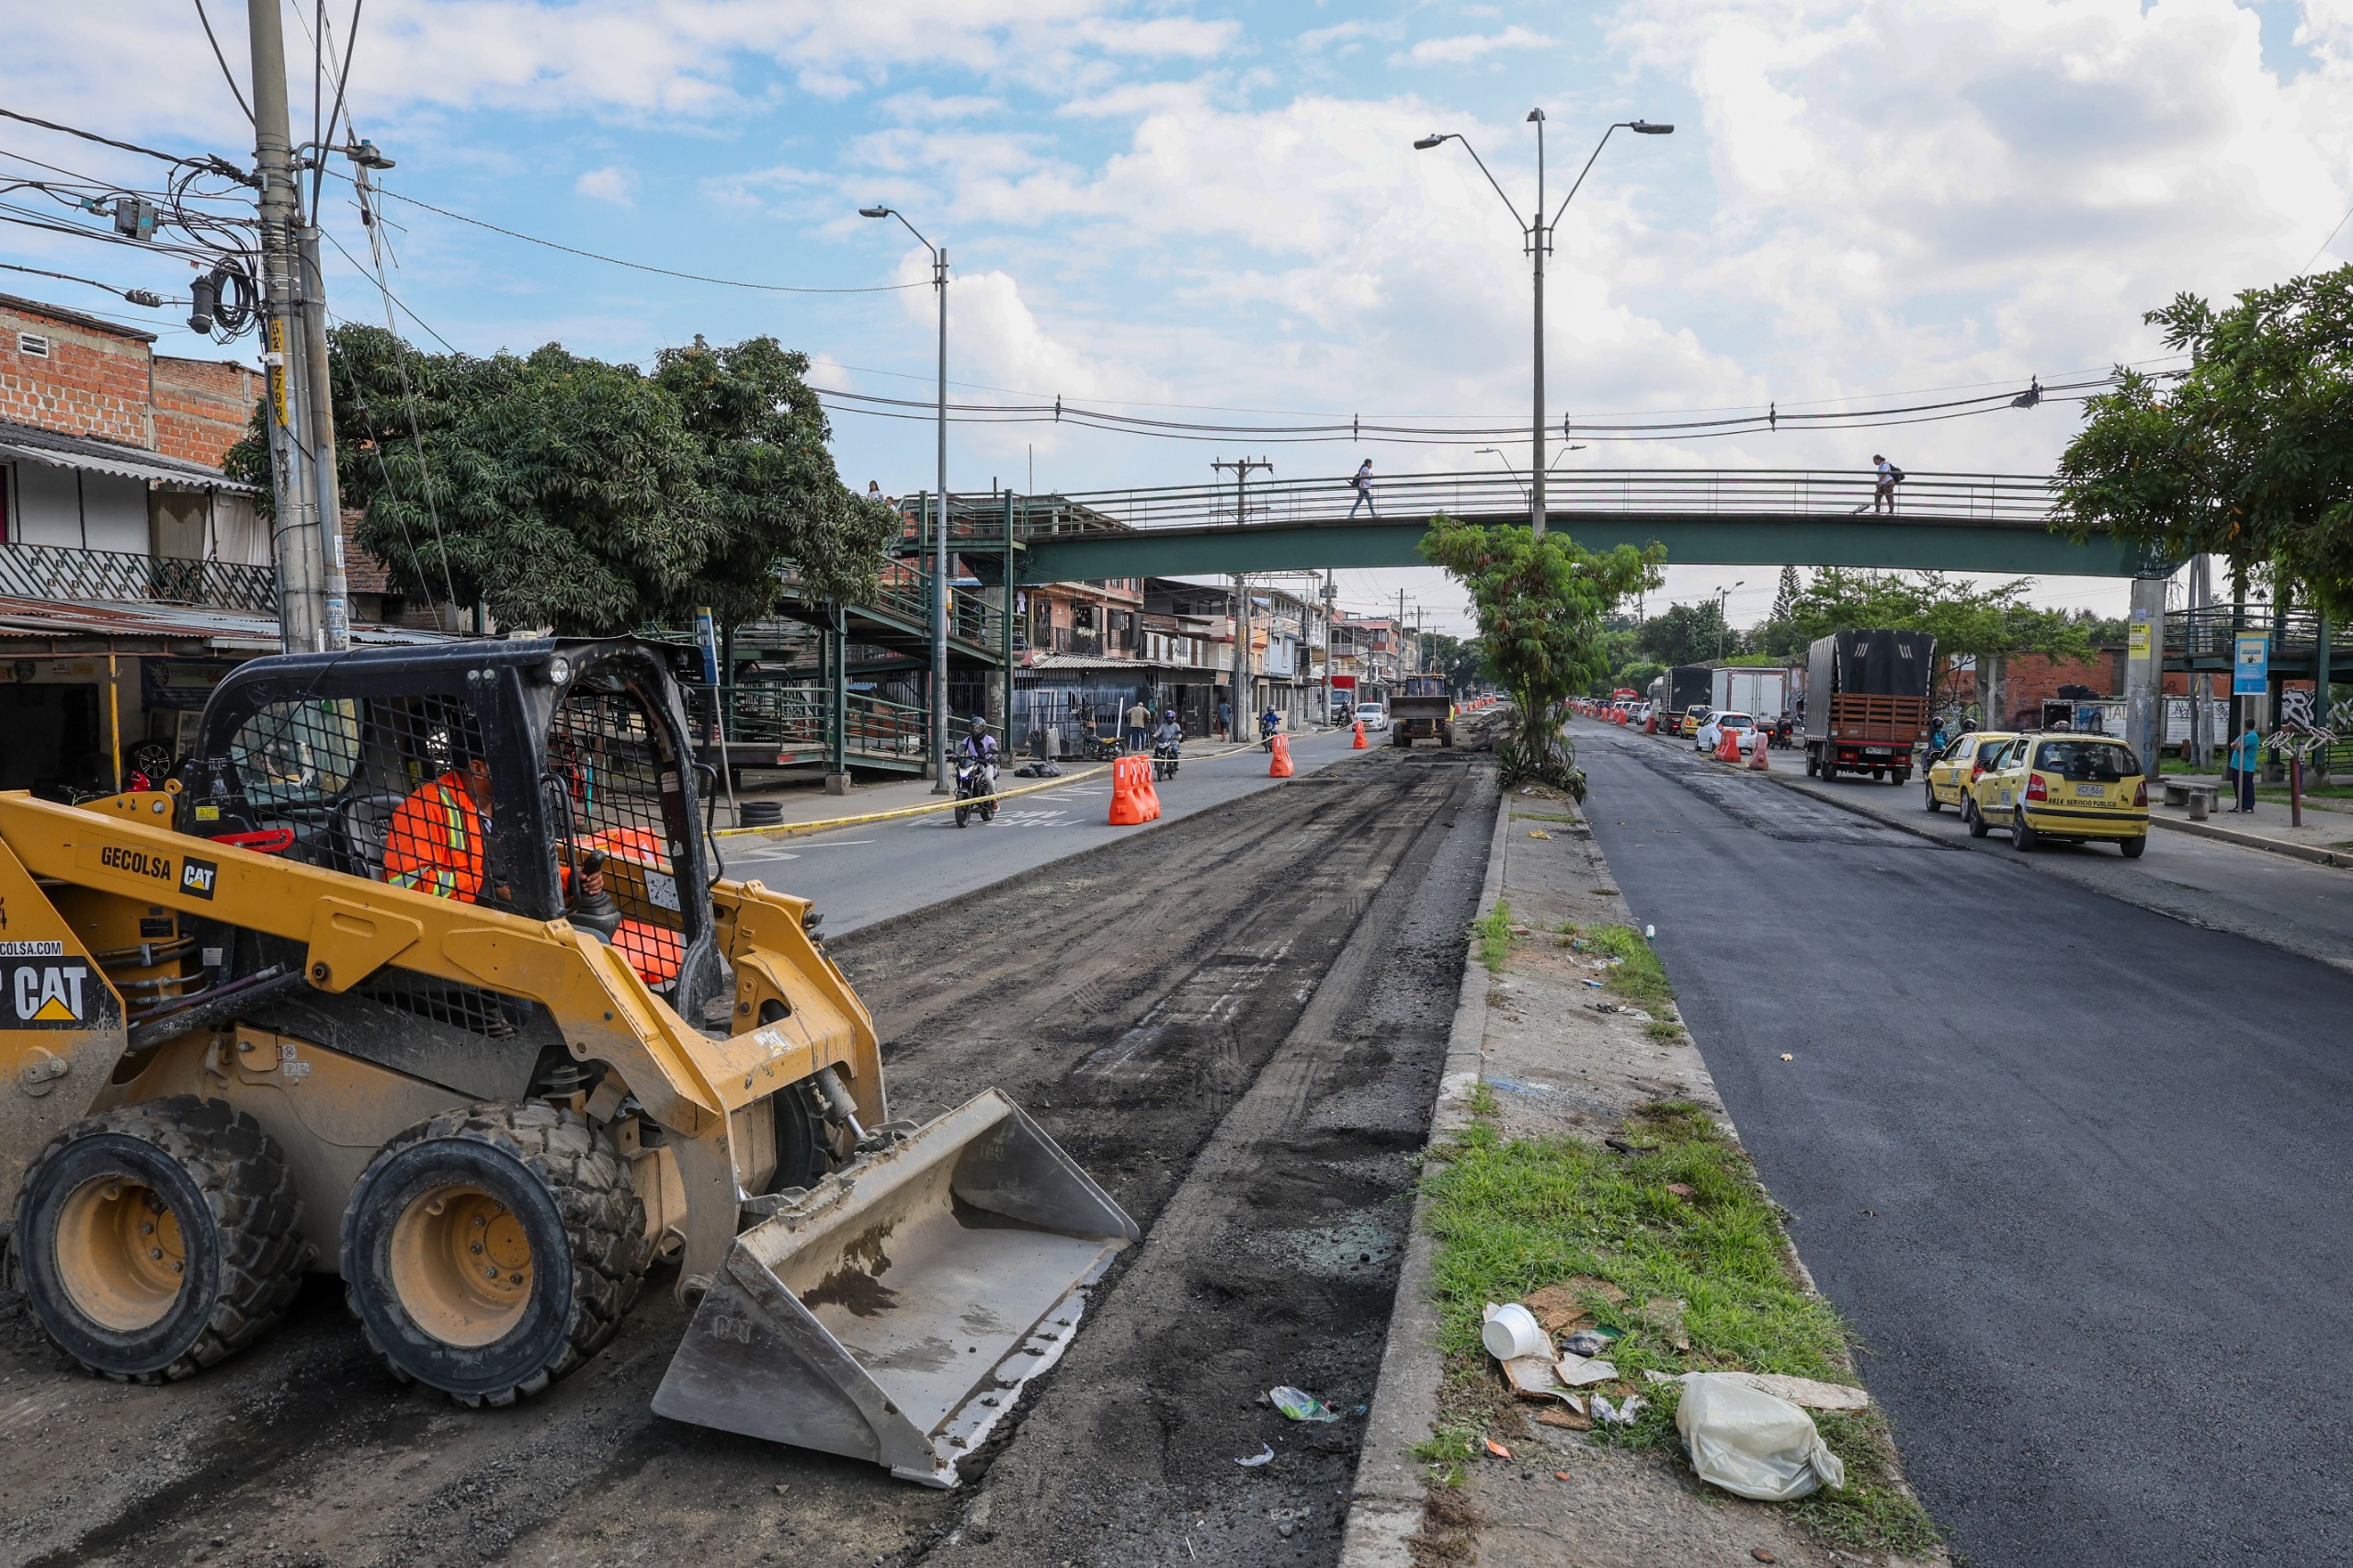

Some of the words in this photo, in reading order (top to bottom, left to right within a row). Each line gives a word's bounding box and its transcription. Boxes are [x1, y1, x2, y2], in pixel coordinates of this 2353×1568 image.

[271, 323, 283, 417] 522798
[2048, 797, 2064, 805] 6814
[101, 846, 171, 881] GECOLSA
[183, 865, 214, 891] CAT
[14, 966, 87, 1020] CAT
